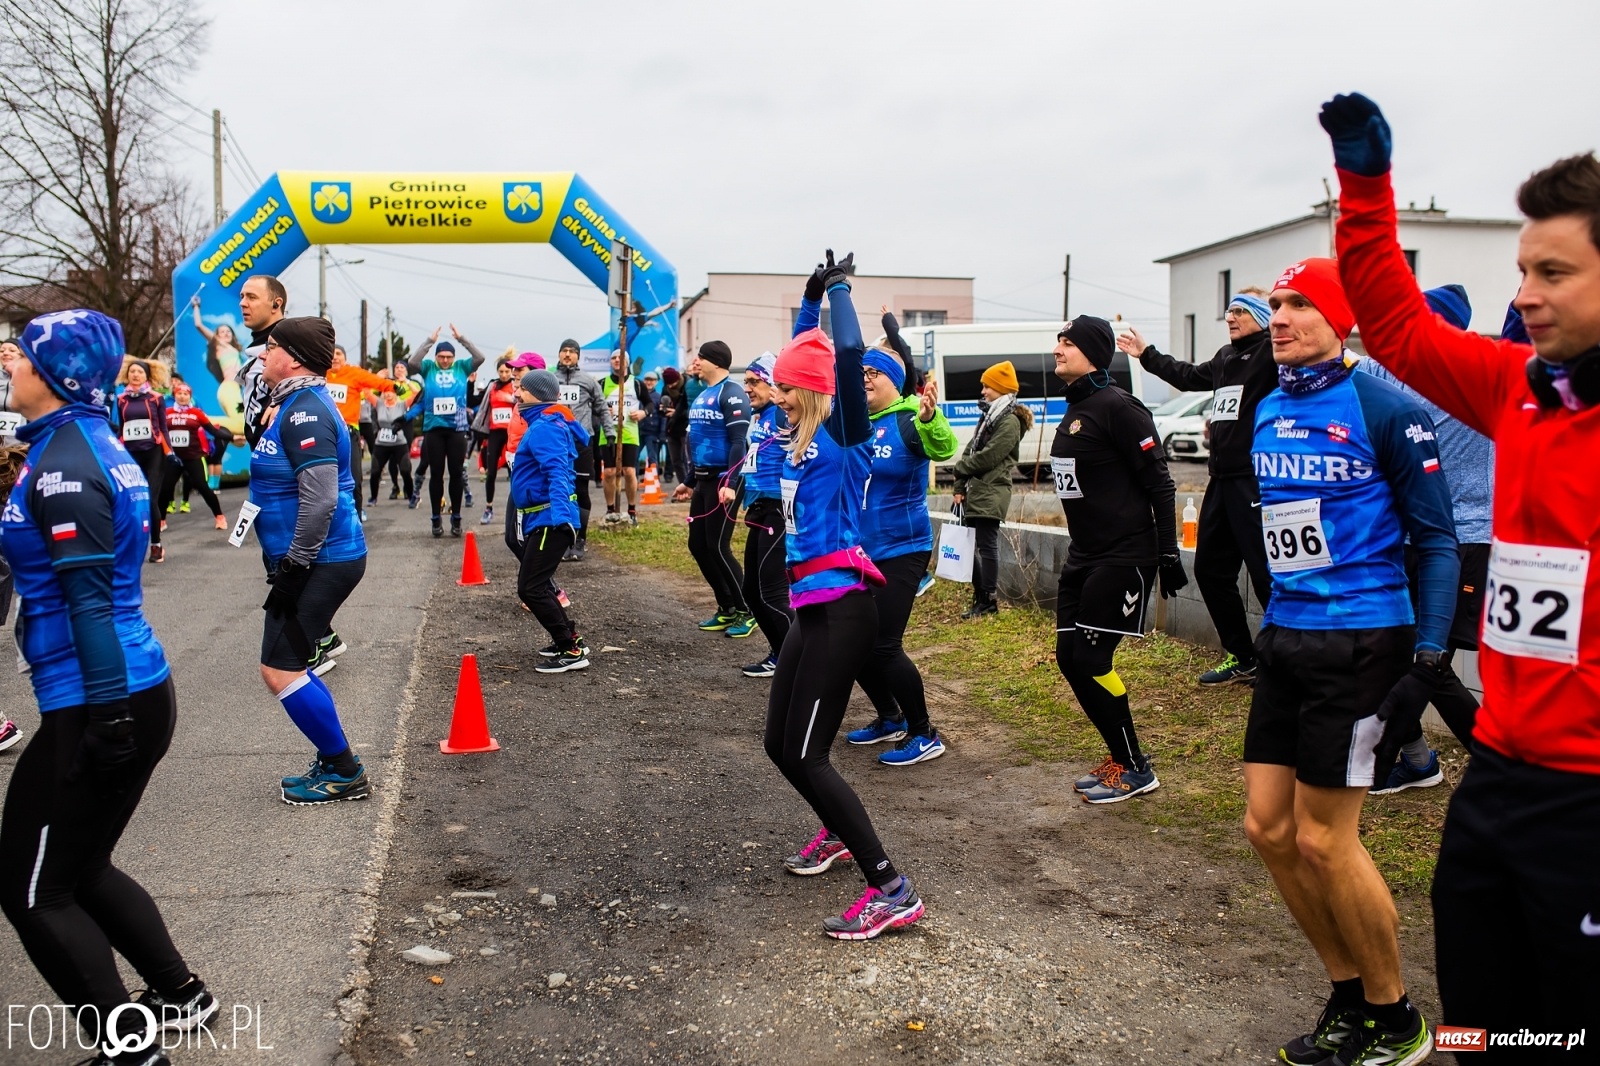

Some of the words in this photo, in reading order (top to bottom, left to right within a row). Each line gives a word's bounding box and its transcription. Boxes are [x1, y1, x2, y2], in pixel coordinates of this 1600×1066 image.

[389, 181, 466, 192] Gmina
[369, 196, 487, 210] Pietrowice
[385, 213, 472, 227] Wielkie
[574, 197, 616, 241] Gmina
[200, 232, 245, 274] Gmina
[241, 196, 279, 234] ludzi
[219, 215, 294, 288] aktywnych
[126, 426, 150, 436] 153
[1267, 525, 1322, 560] 396
